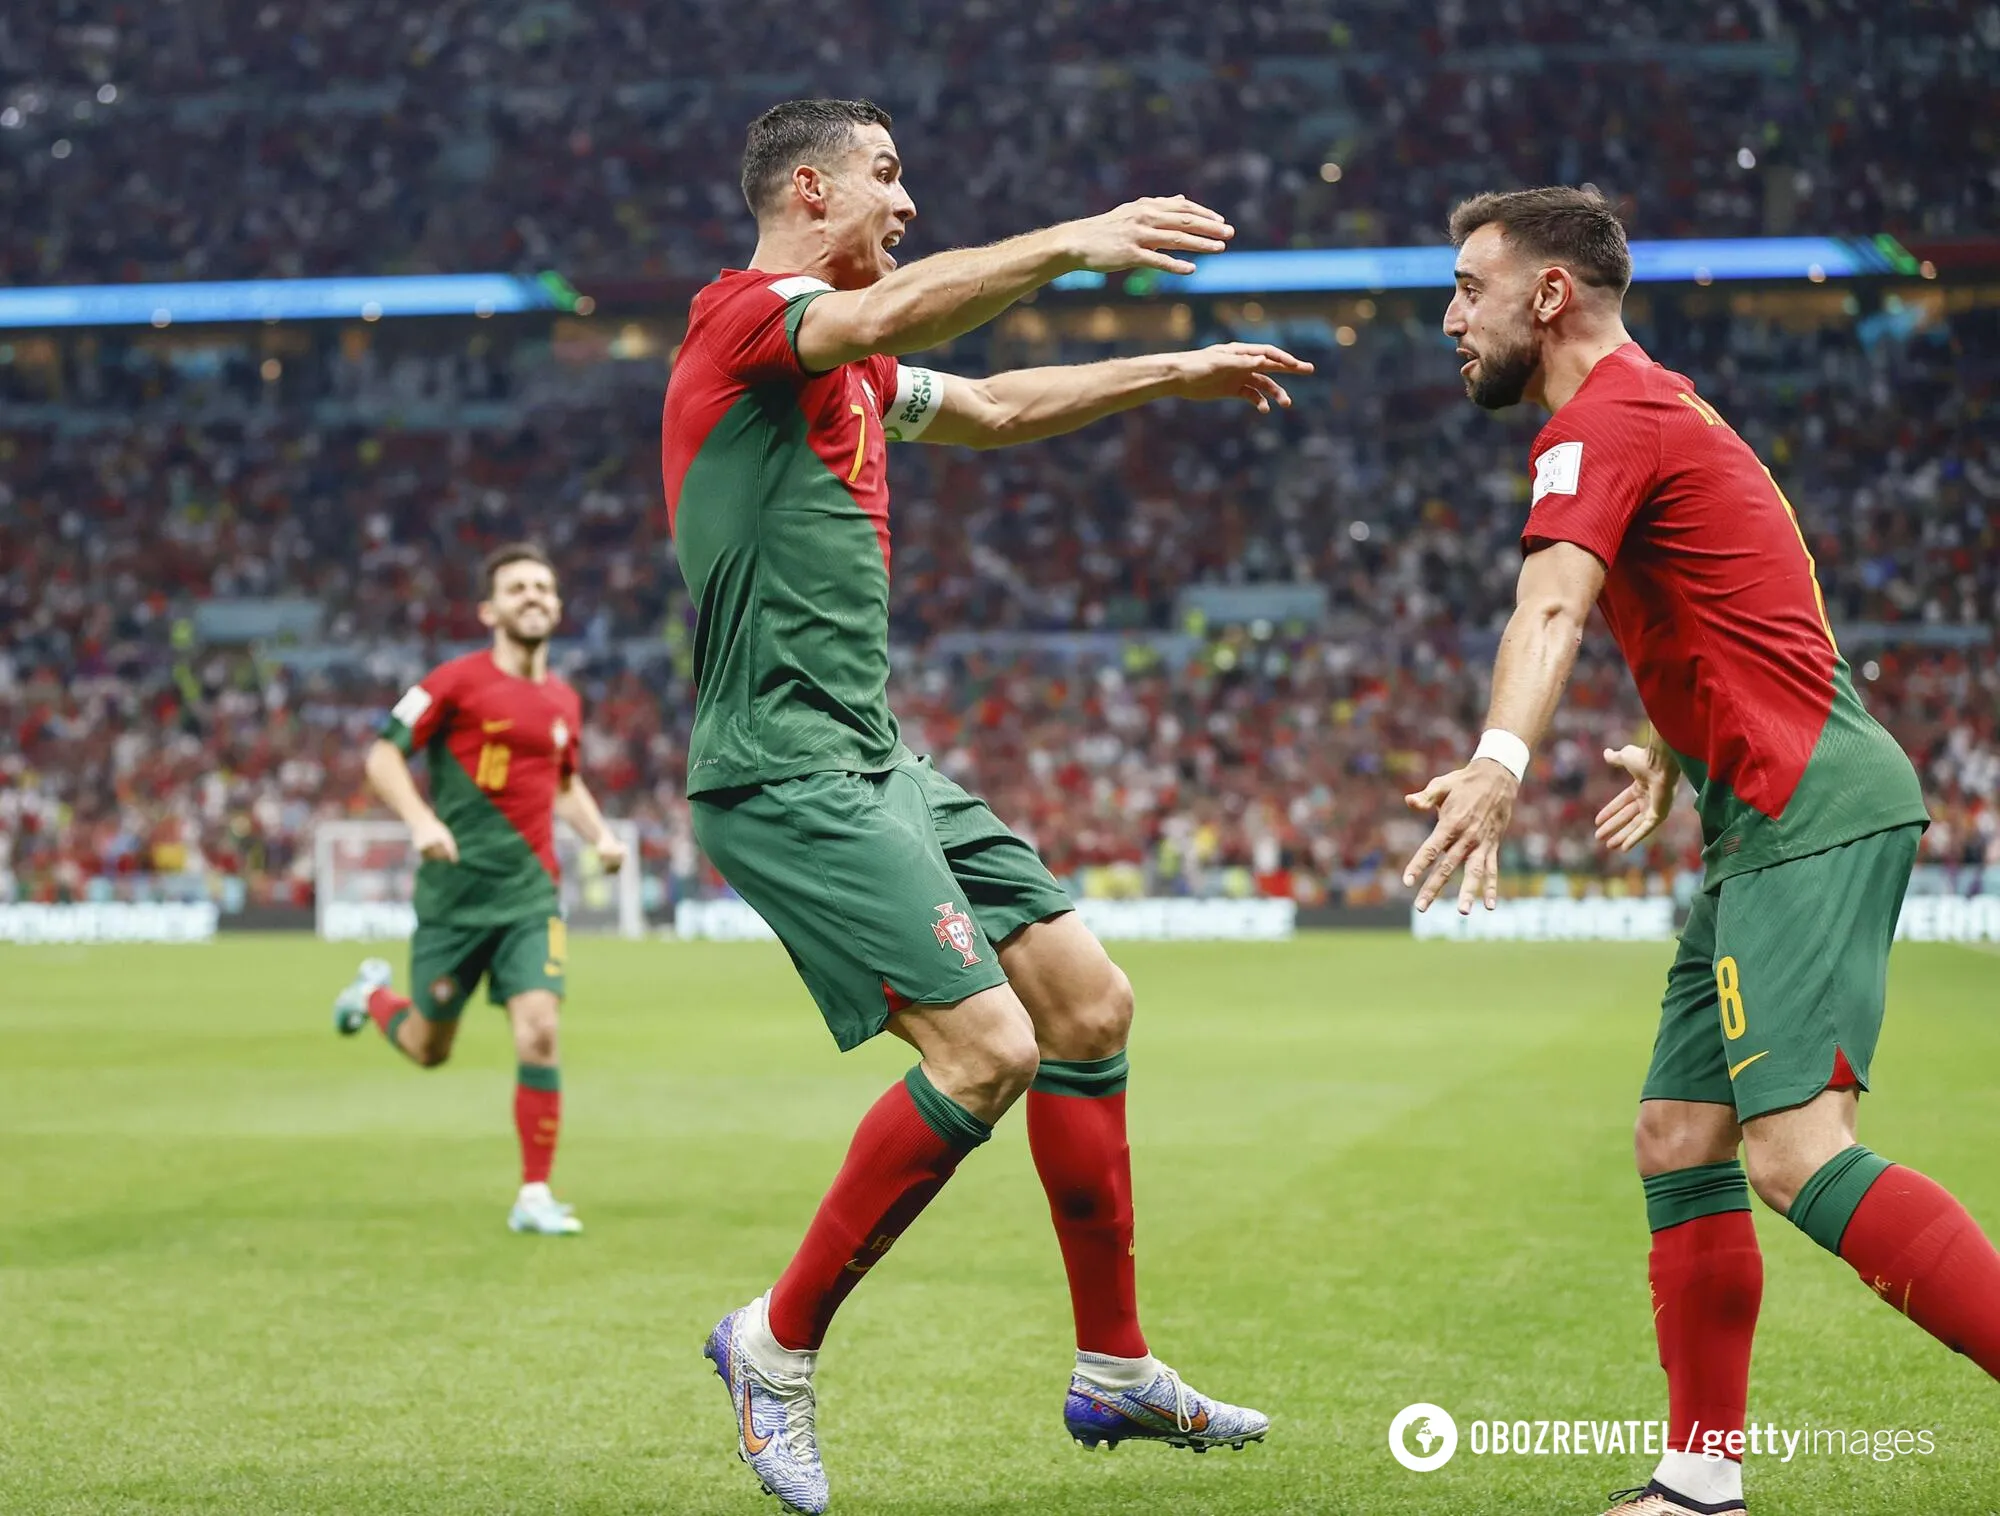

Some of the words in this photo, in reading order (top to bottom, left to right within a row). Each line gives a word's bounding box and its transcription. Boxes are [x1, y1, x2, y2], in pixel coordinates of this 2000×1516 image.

[899, 383, 922, 422] SAVE
[847, 403, 866, 483] 7
[1716, 955, 1746, 1041] 8
